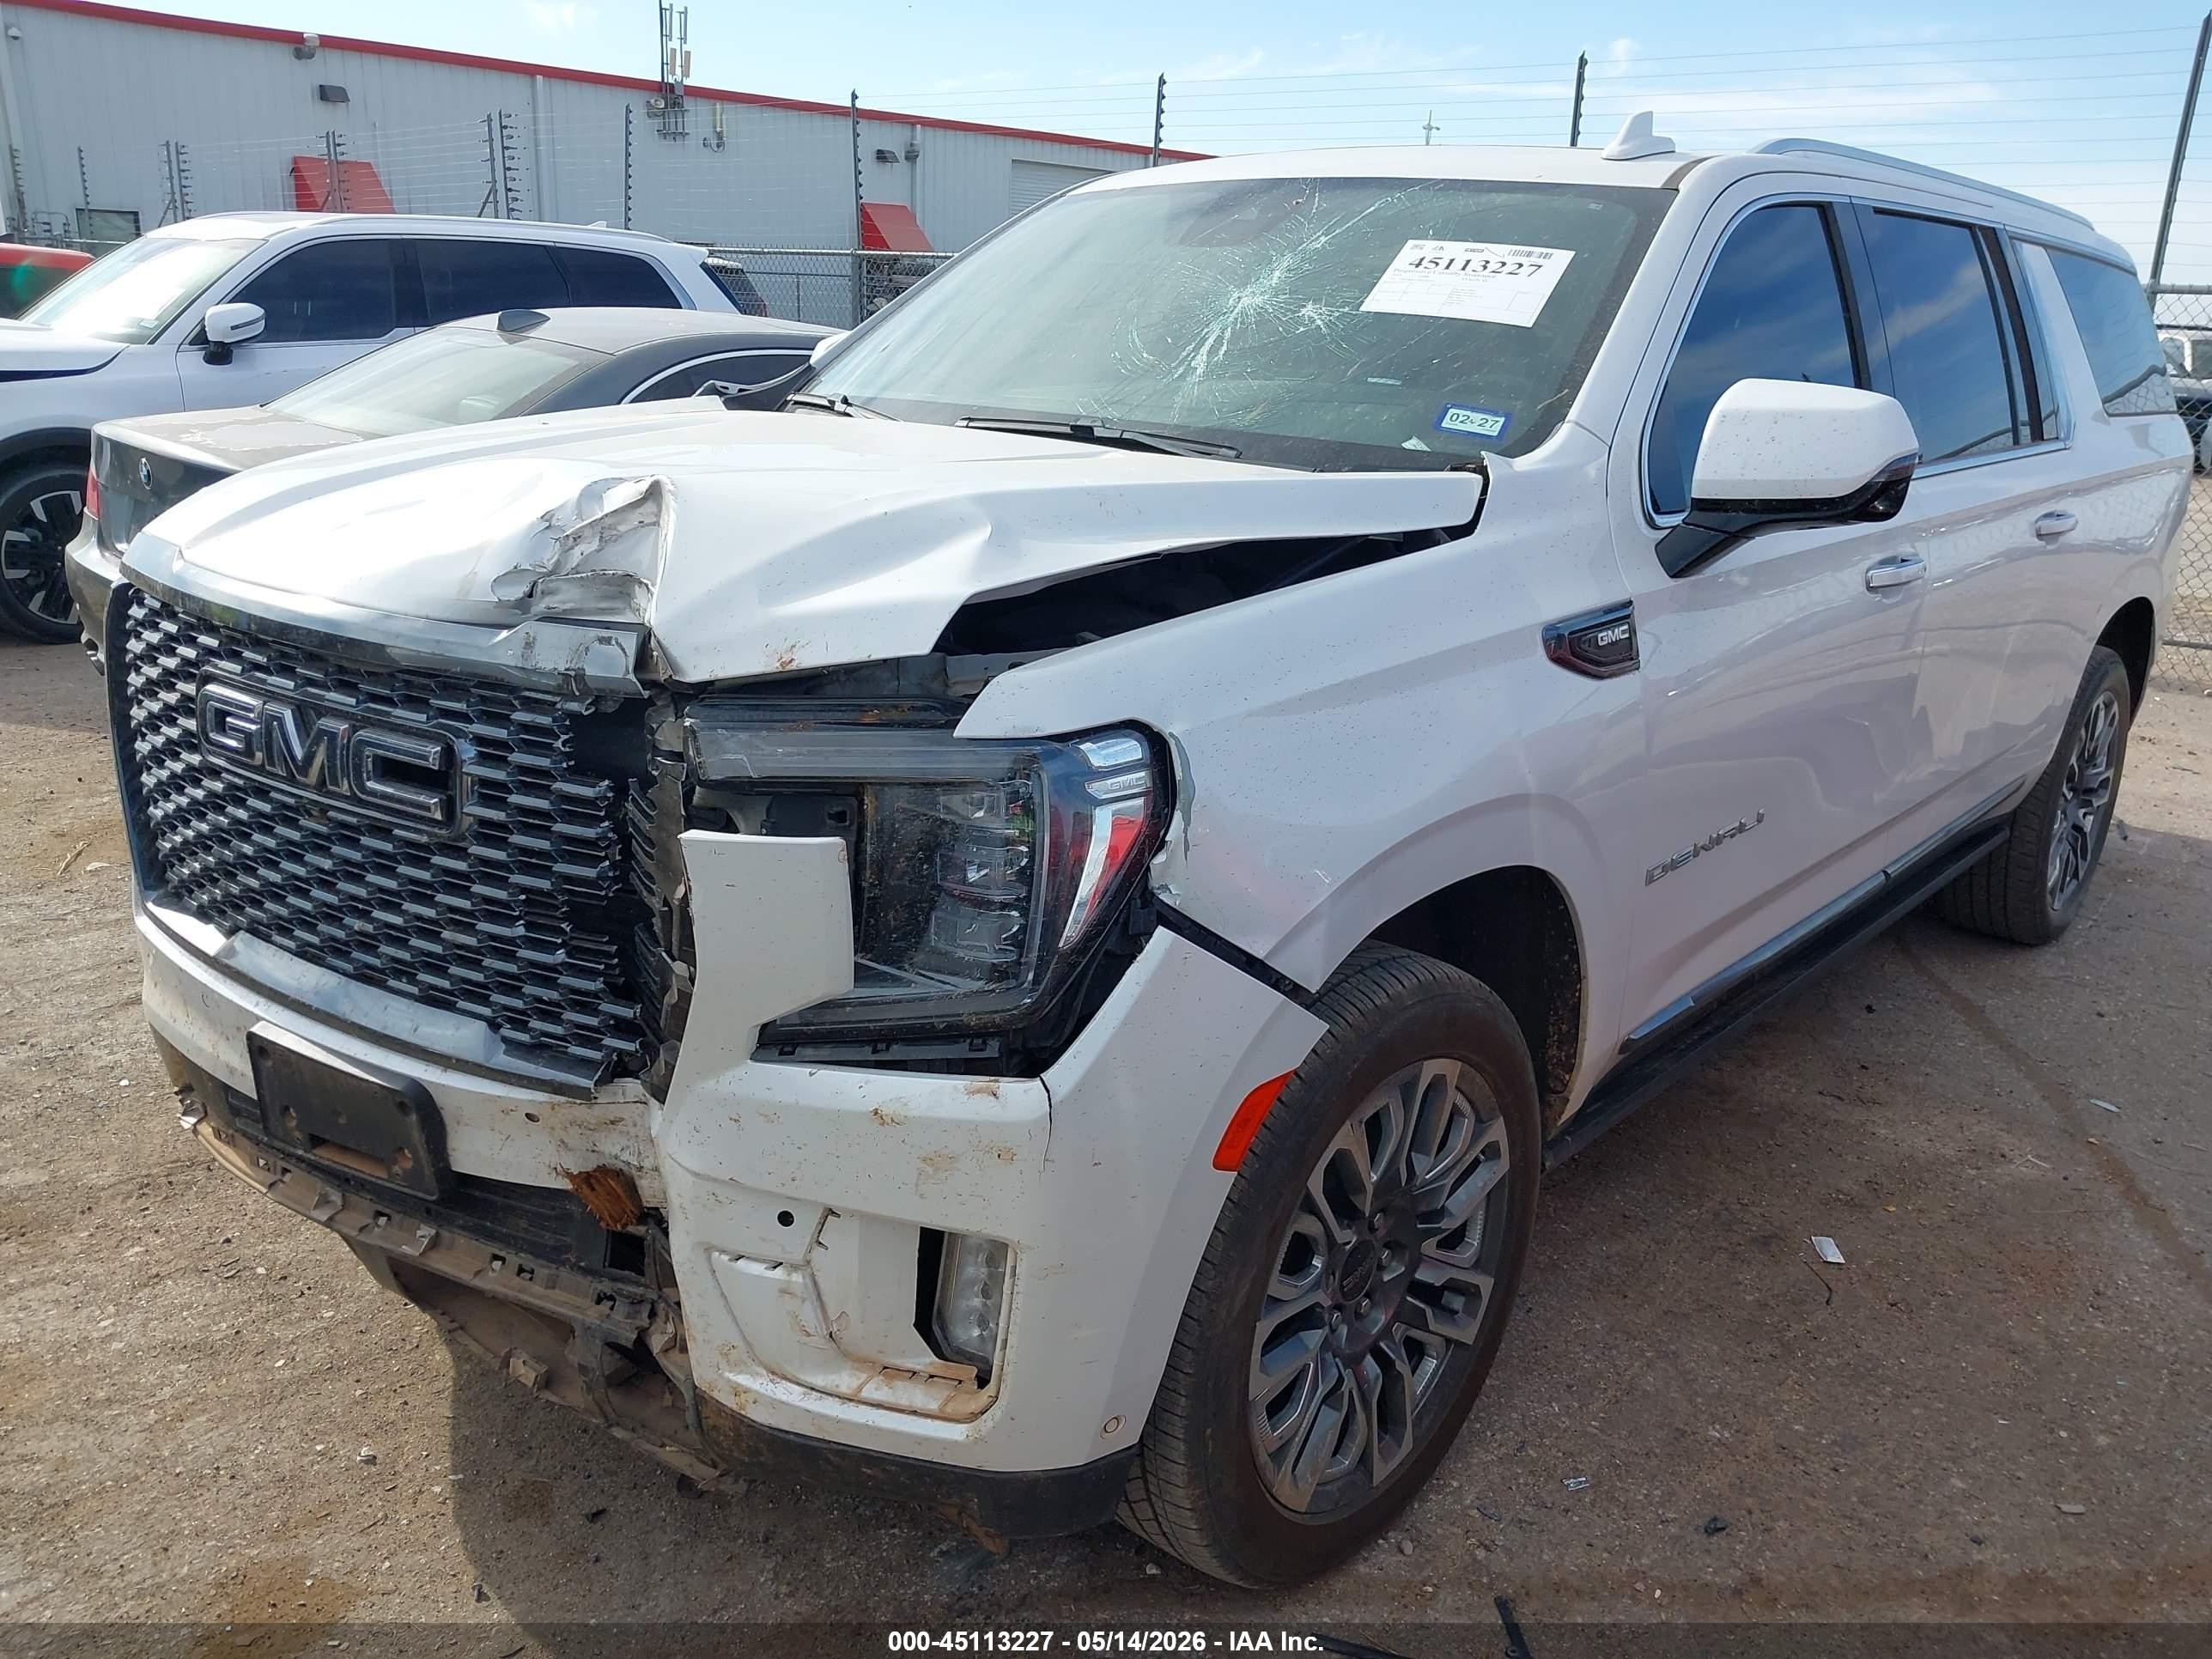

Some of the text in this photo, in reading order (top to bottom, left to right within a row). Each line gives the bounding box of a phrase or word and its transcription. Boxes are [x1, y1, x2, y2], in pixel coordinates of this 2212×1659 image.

[1408, 256, 1543, 277] 45113227
[1597, 625, 1629, 647] GMC
[198, 683, 443, 821] GMC
[1109, 775, 1146, 790] GMC
[1645, 805, 1765, 886] DENALI
